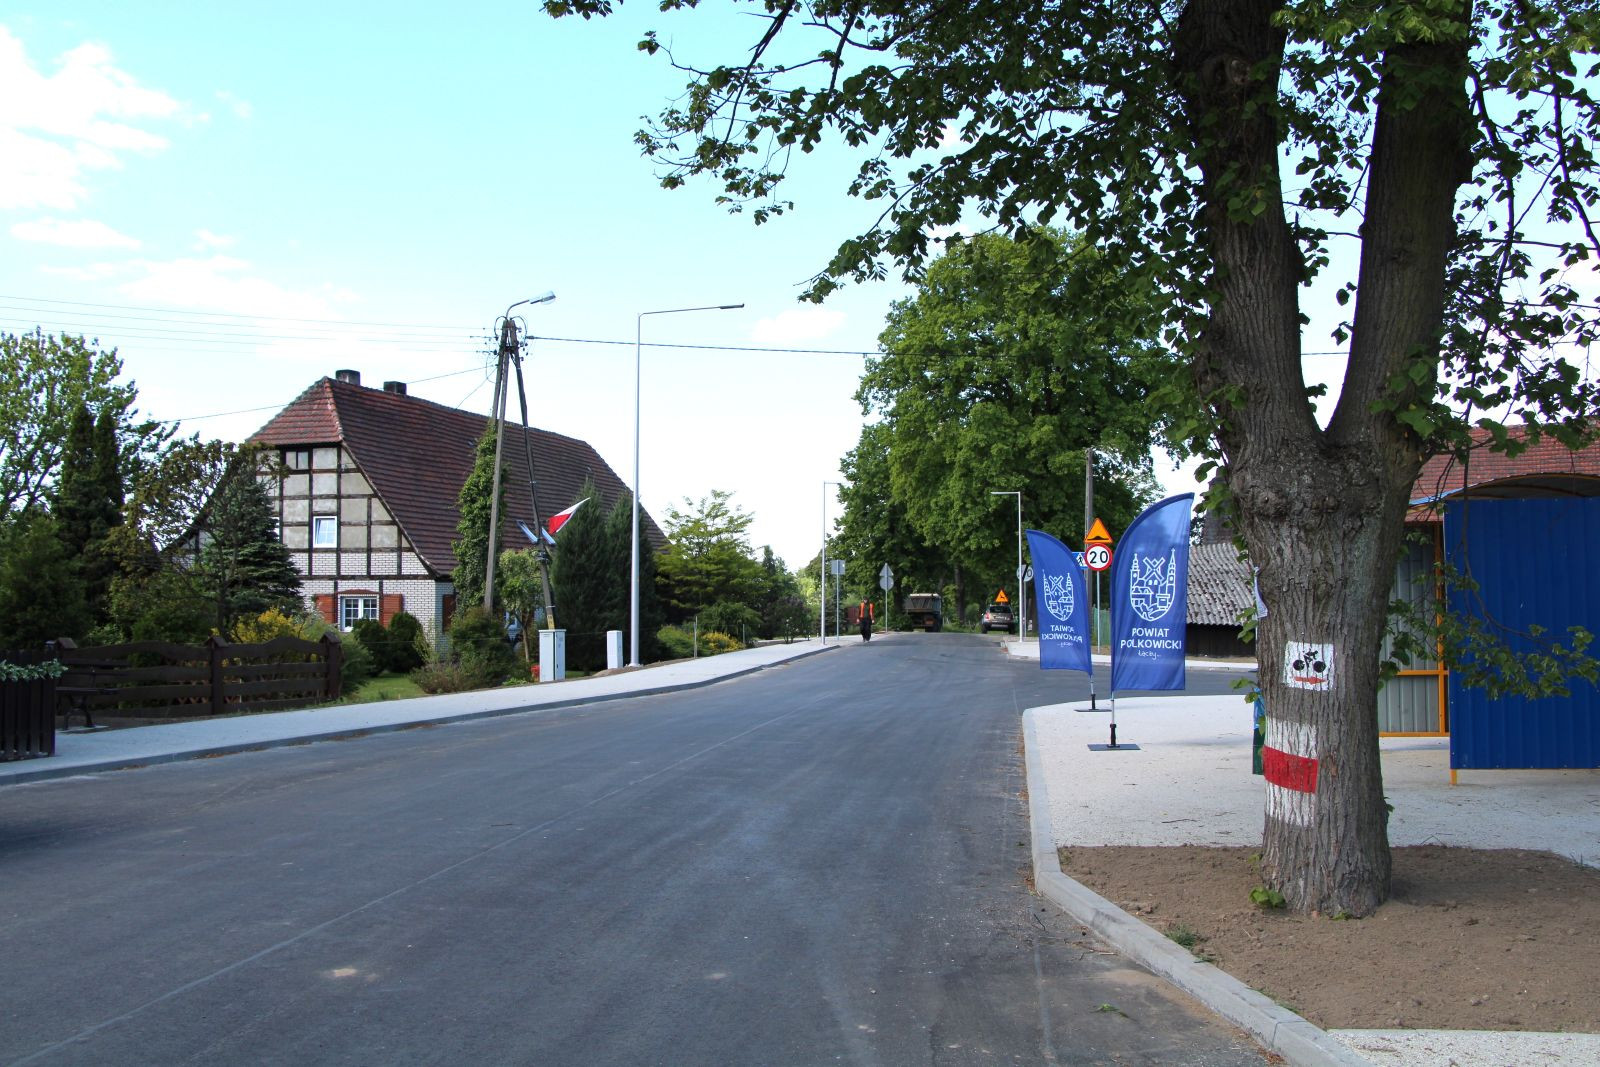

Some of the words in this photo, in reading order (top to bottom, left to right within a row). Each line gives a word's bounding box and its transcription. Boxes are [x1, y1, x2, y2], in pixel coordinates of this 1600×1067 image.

[1089, 550, 1109, 564] 20
[1131, 627, 1170, 637] POWIAT
[1120, 639, 1182, 649] POLKOWICKI
